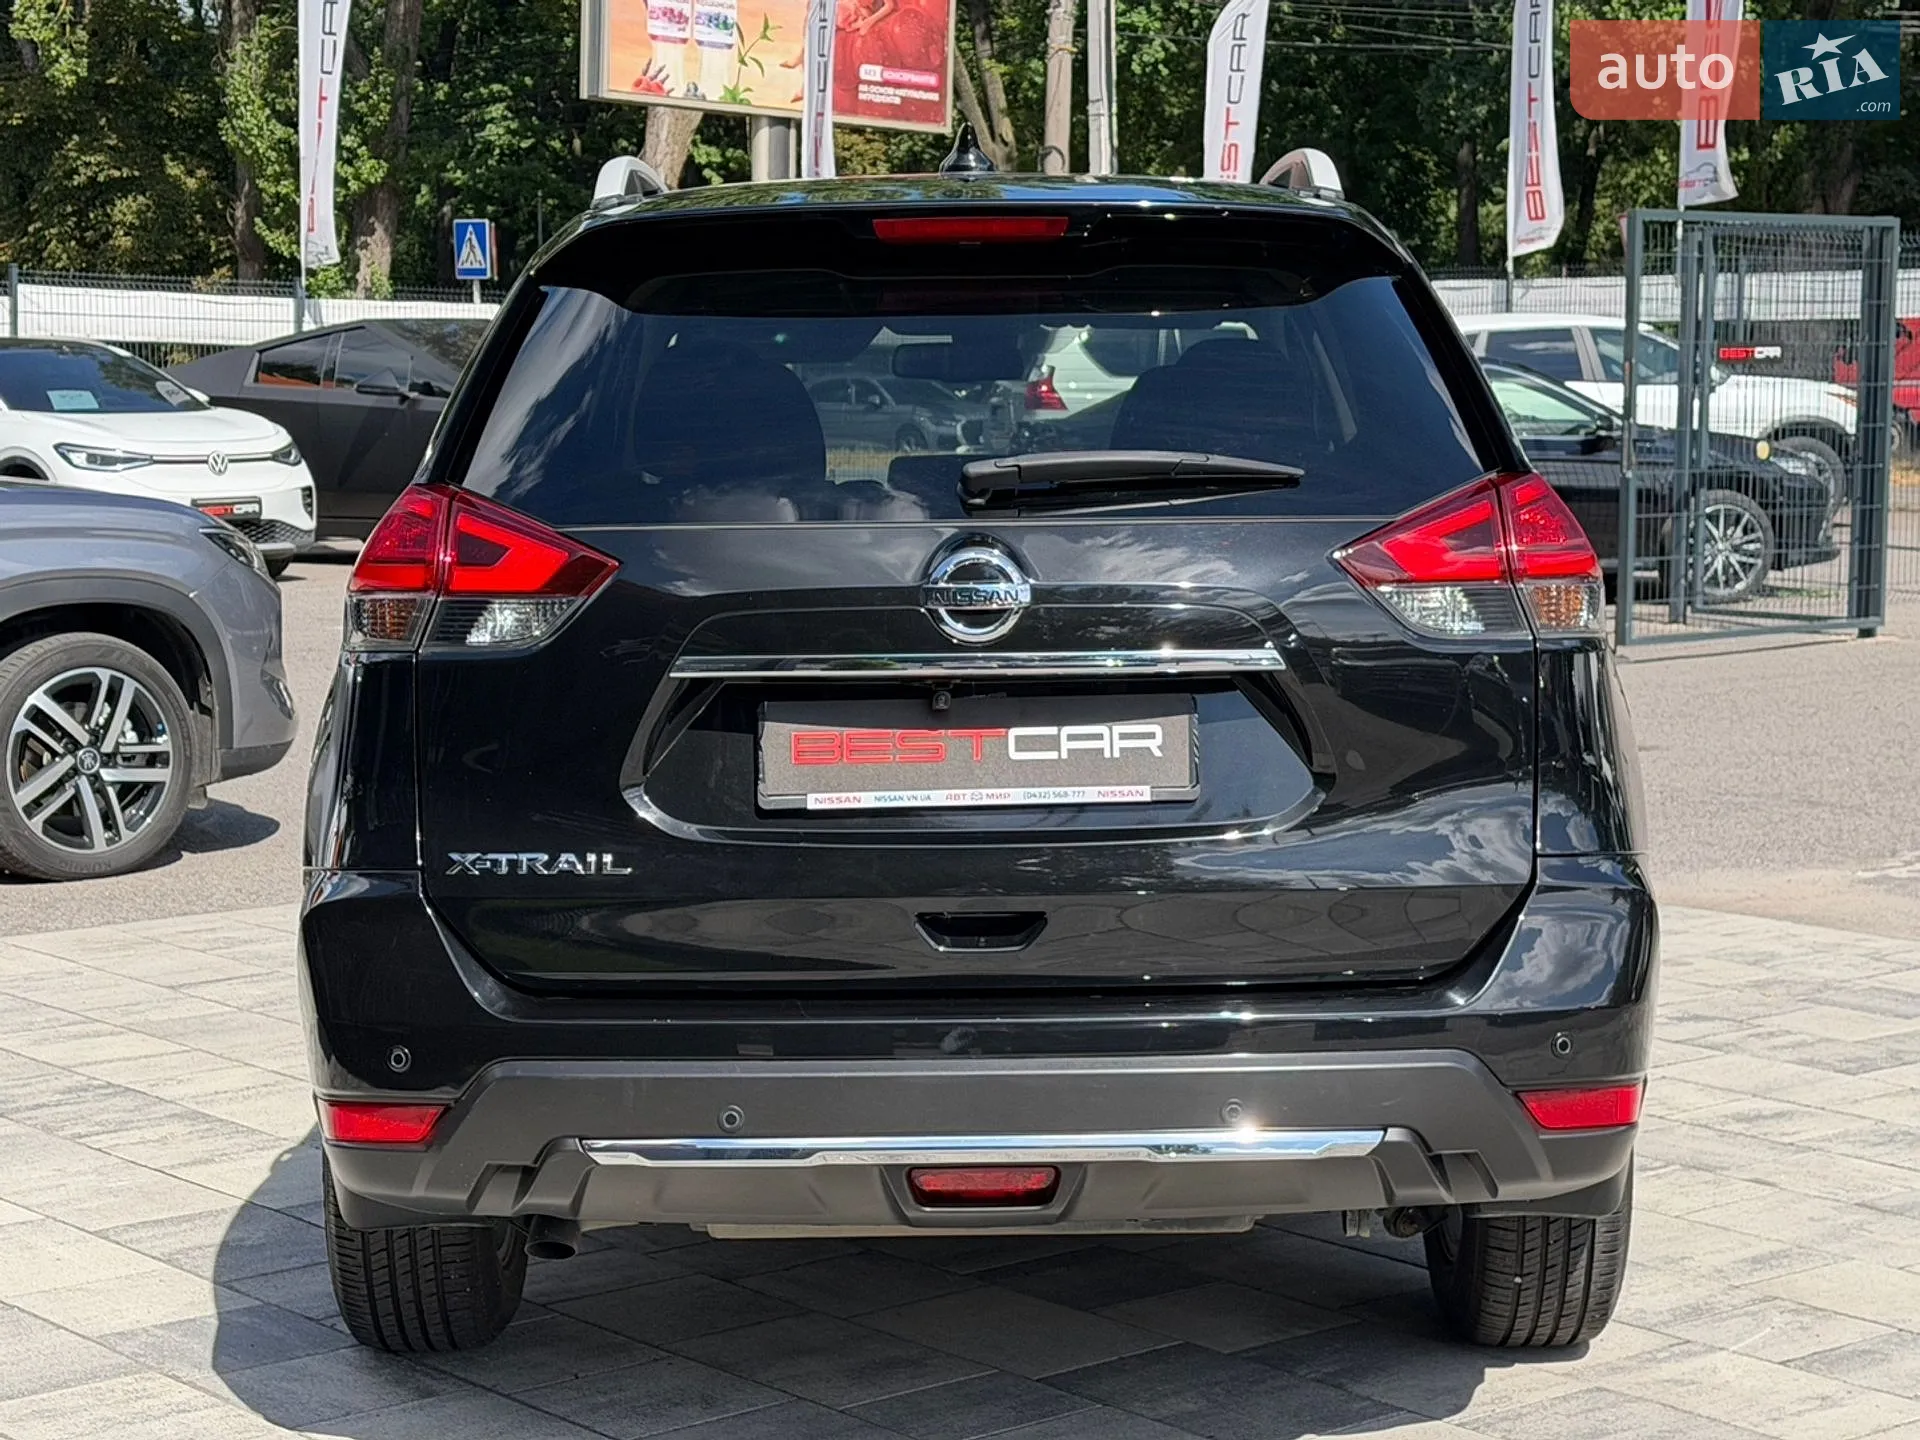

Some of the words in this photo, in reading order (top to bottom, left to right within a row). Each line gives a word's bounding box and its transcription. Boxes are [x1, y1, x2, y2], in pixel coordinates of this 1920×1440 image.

[1220, 12, 1250, 180] STCAR
[931, 589, 1019, 605] NISSAN
[791, 724, 1164, 765] BESTCAR
[814, 796, 862, 805] NISSAN
[1097, 789, 1144, 798] NISSAN
[445, 852, 633, 875] X-TRAIL
